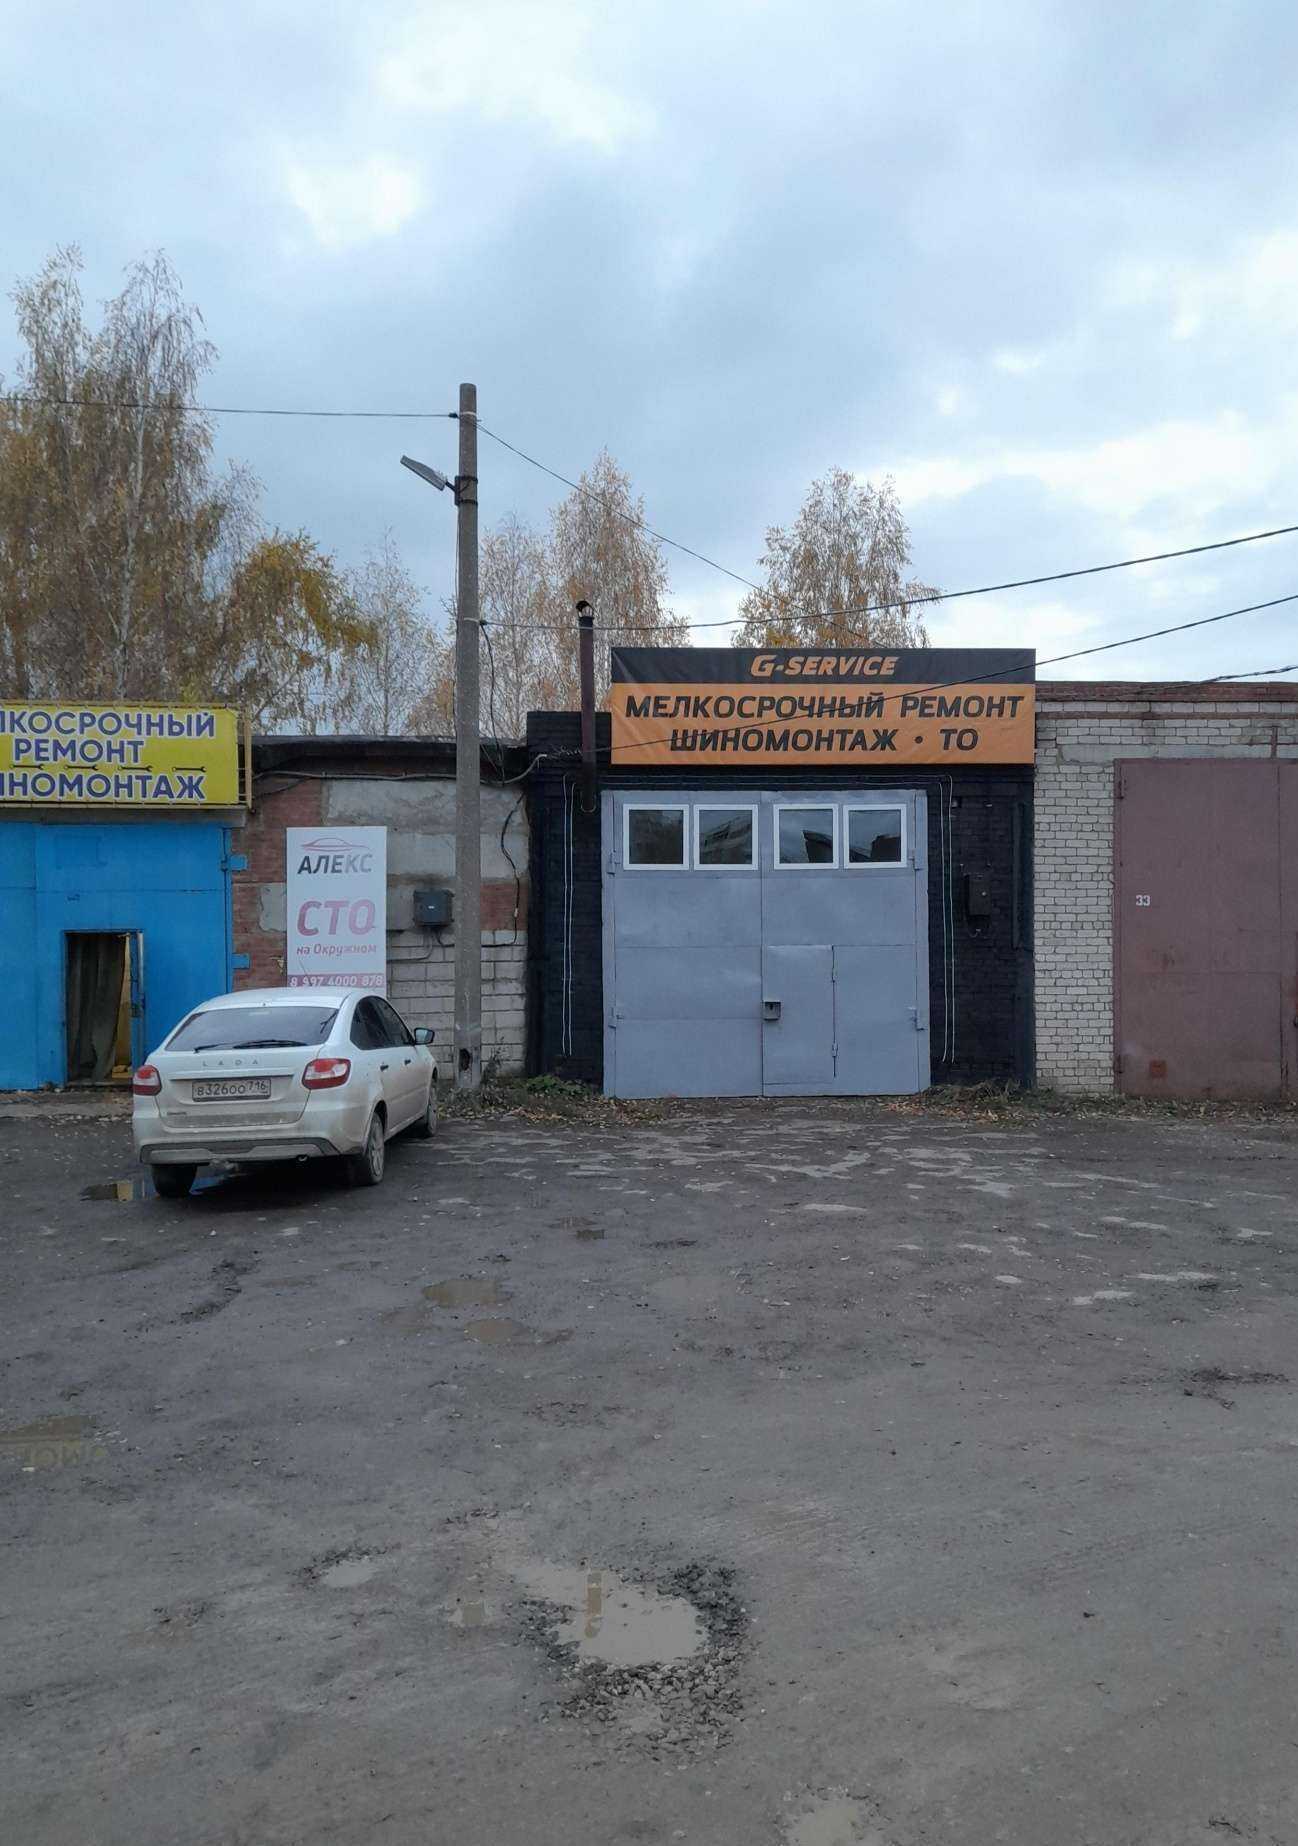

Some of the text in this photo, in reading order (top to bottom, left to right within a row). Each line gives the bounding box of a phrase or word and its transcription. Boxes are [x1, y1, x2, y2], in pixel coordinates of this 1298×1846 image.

[751, 654, 899, 678] G-SERVICE
[626, 692, 1024, 719] МЕЛКОСРОЧНЫЙ РЕМОНТ
[14, 739, 144, 763] РЕМОНТ
[671, 729, 979, 752] ШИНОМОНТАЖ ТО
[0, 773, 205, 799] НОМОНТАЖ
[297, 854, 373, 875] АЛЕКС
[1135, 894, 1151, 907] 33
[297, 900, 376, 937] СТО
[202, 1059, 259, 1067] LADA
